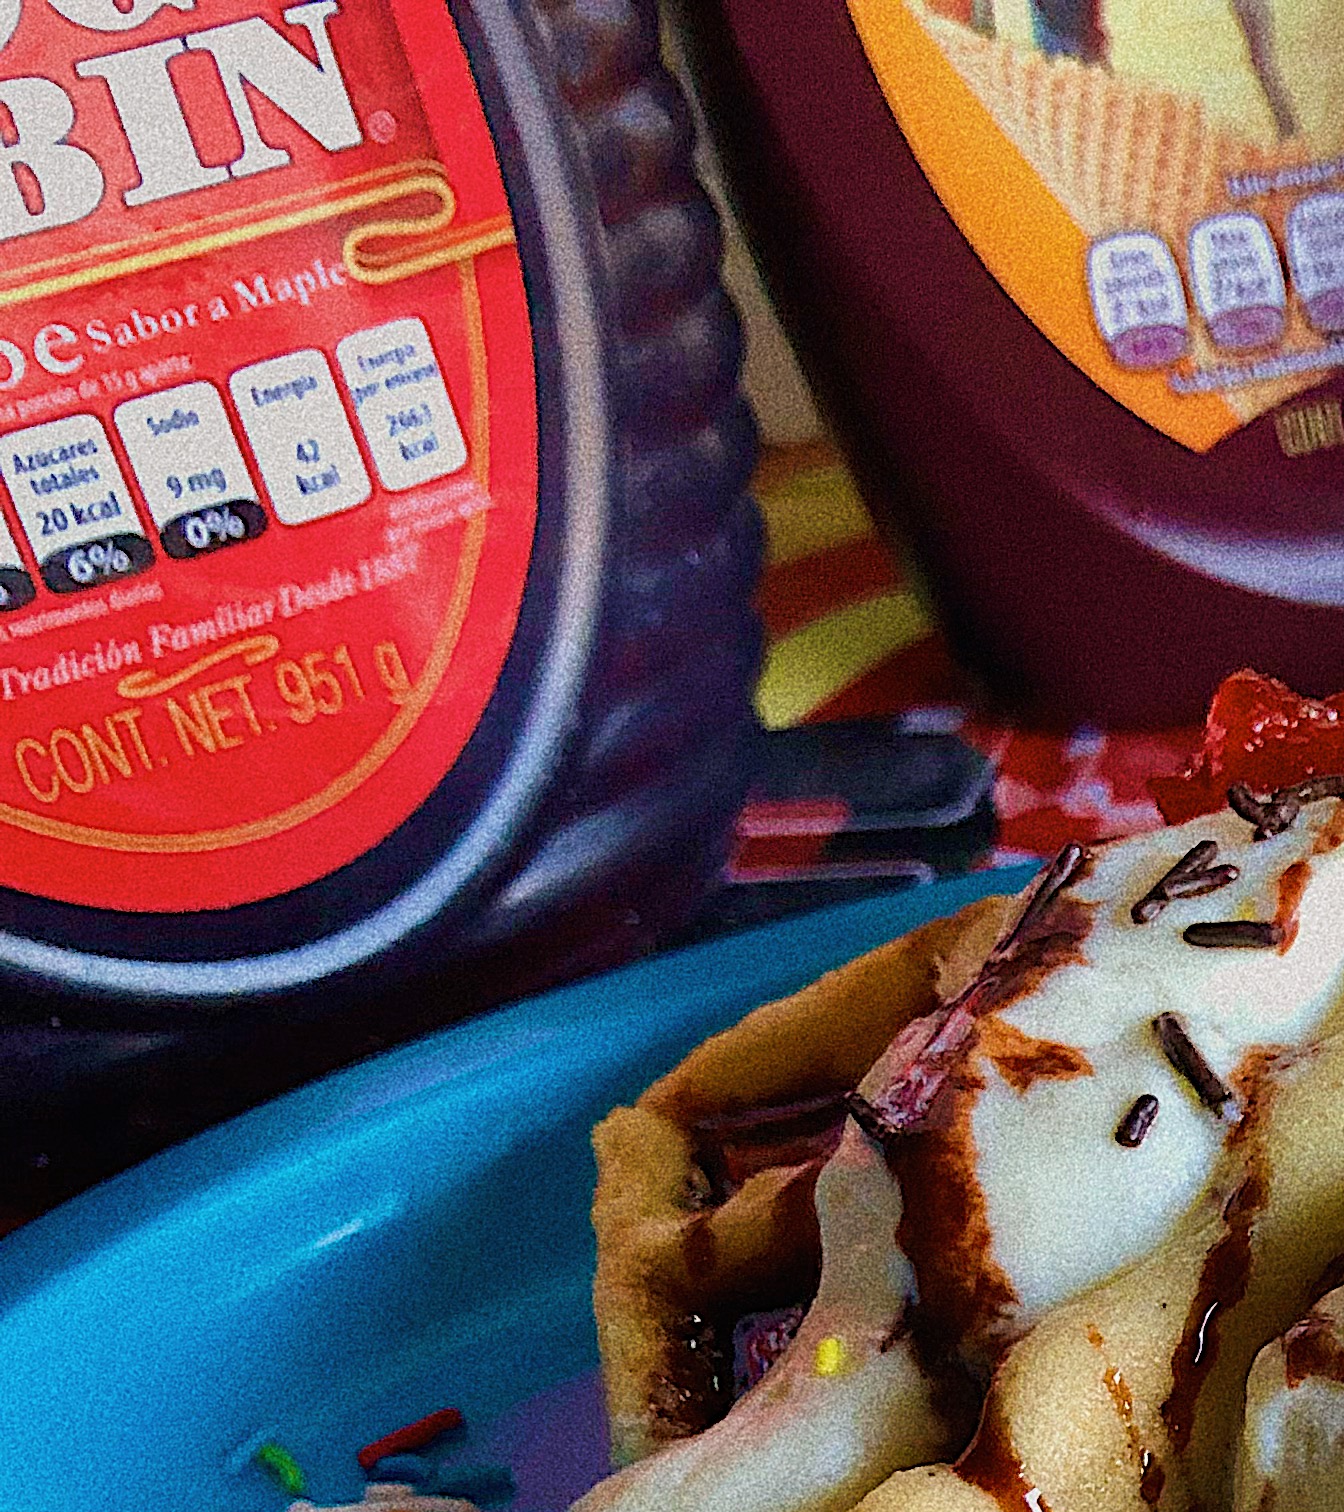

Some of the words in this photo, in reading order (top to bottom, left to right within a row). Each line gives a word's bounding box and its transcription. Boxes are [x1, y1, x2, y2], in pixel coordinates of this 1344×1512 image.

[86, 303, 200, 353] Sabor
[208, 296, 229, 321] a
[233, 260, 346, 313] Maple
[166, 475, 184, 499] 9
[188, 467, 228, 494] mg
[36, 506, 69, 537] 20
[69, 490, 122, 526] kcal
[184, 506, 246, 549] 0%
[67, 541, 132, 584] 6%
[1, 636, 143, 701] Tradición
[149, 600, 275, 662] Familiar
[278, 566, 357, 619] Desde
[15, 706, 169, 804] CONT.
[167, 673, 278, 757] NET.
[277, 642, 366, 725] 951
[376, 640, 417, 706] g
